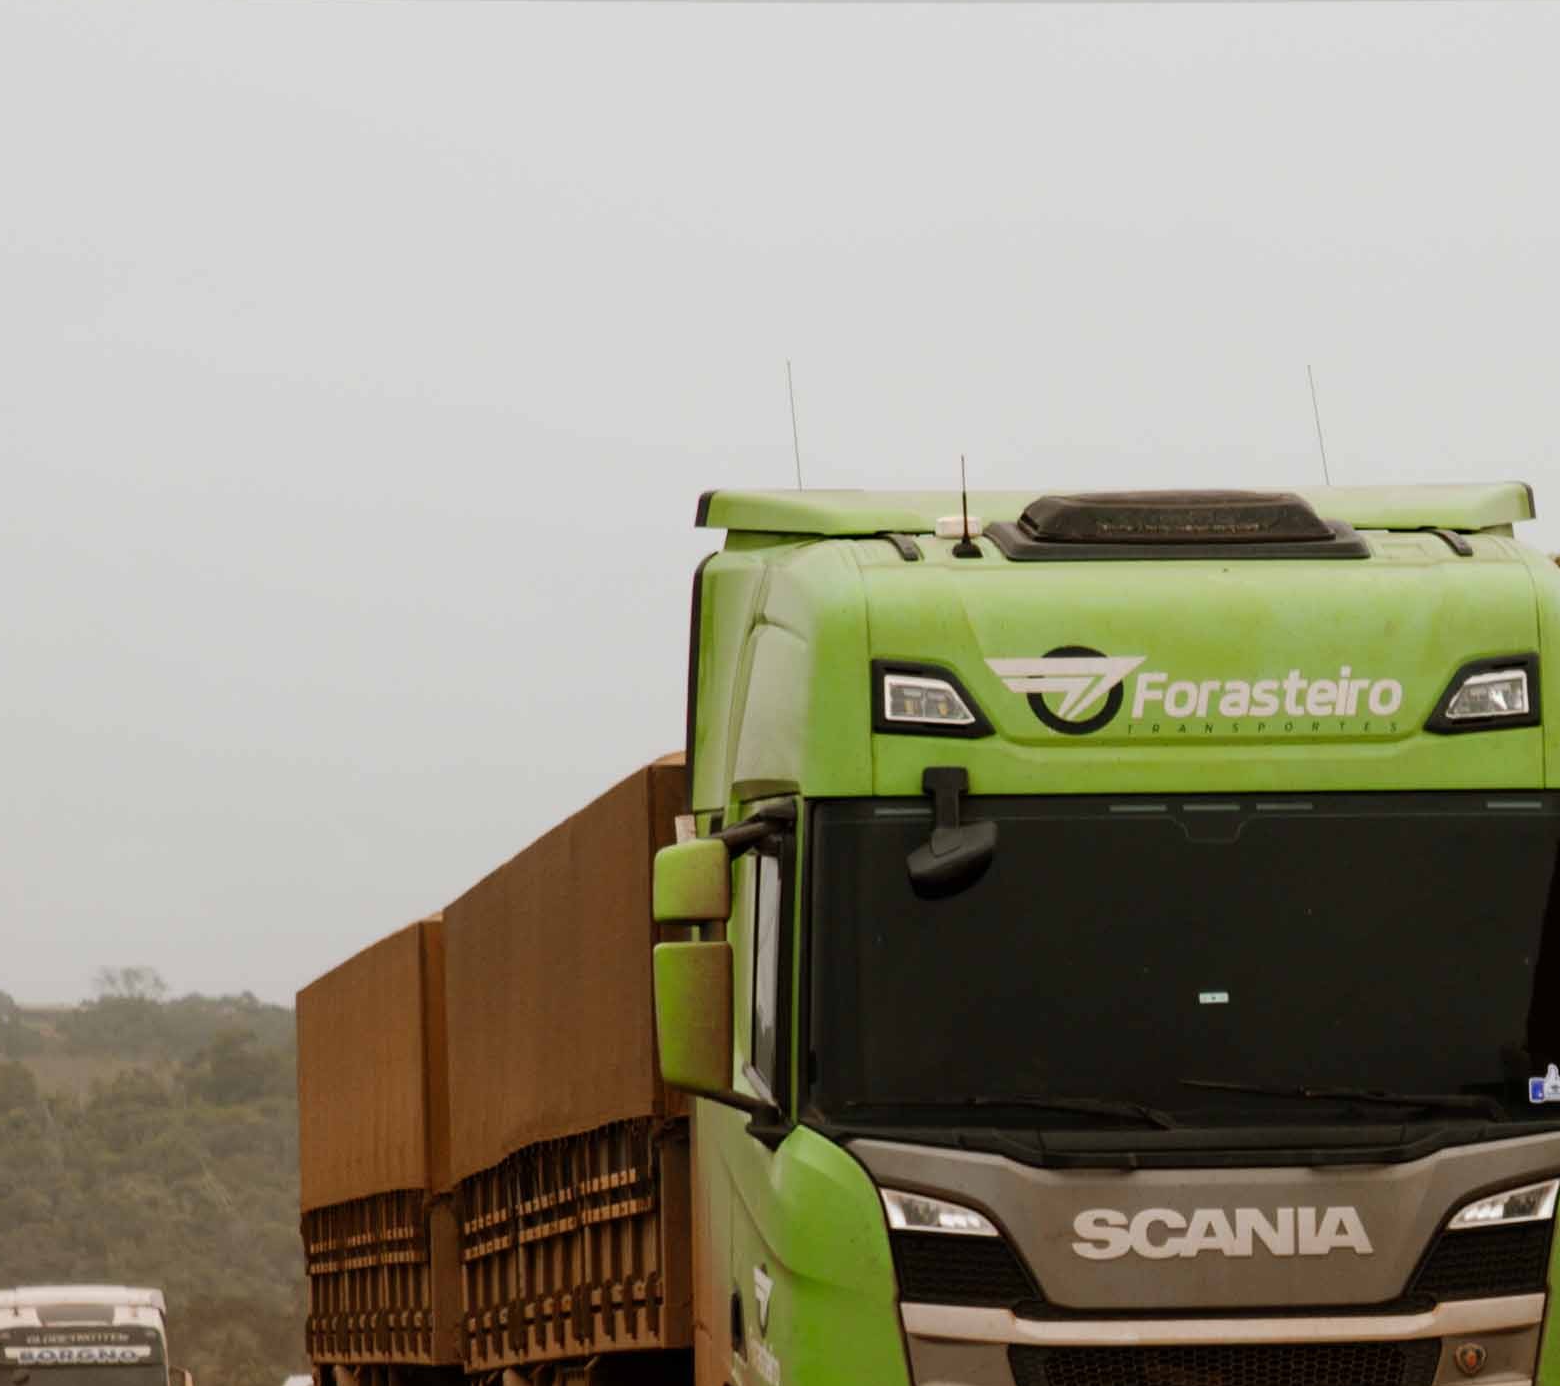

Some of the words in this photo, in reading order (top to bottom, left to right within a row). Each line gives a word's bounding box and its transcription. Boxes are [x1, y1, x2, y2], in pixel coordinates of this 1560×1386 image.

[1132, 666, 1403, 718] Forasteiro
[1127, 721, 1399, 735] TRANSPORTES
[1071, 1206, 1375, 1260] SCANIA
